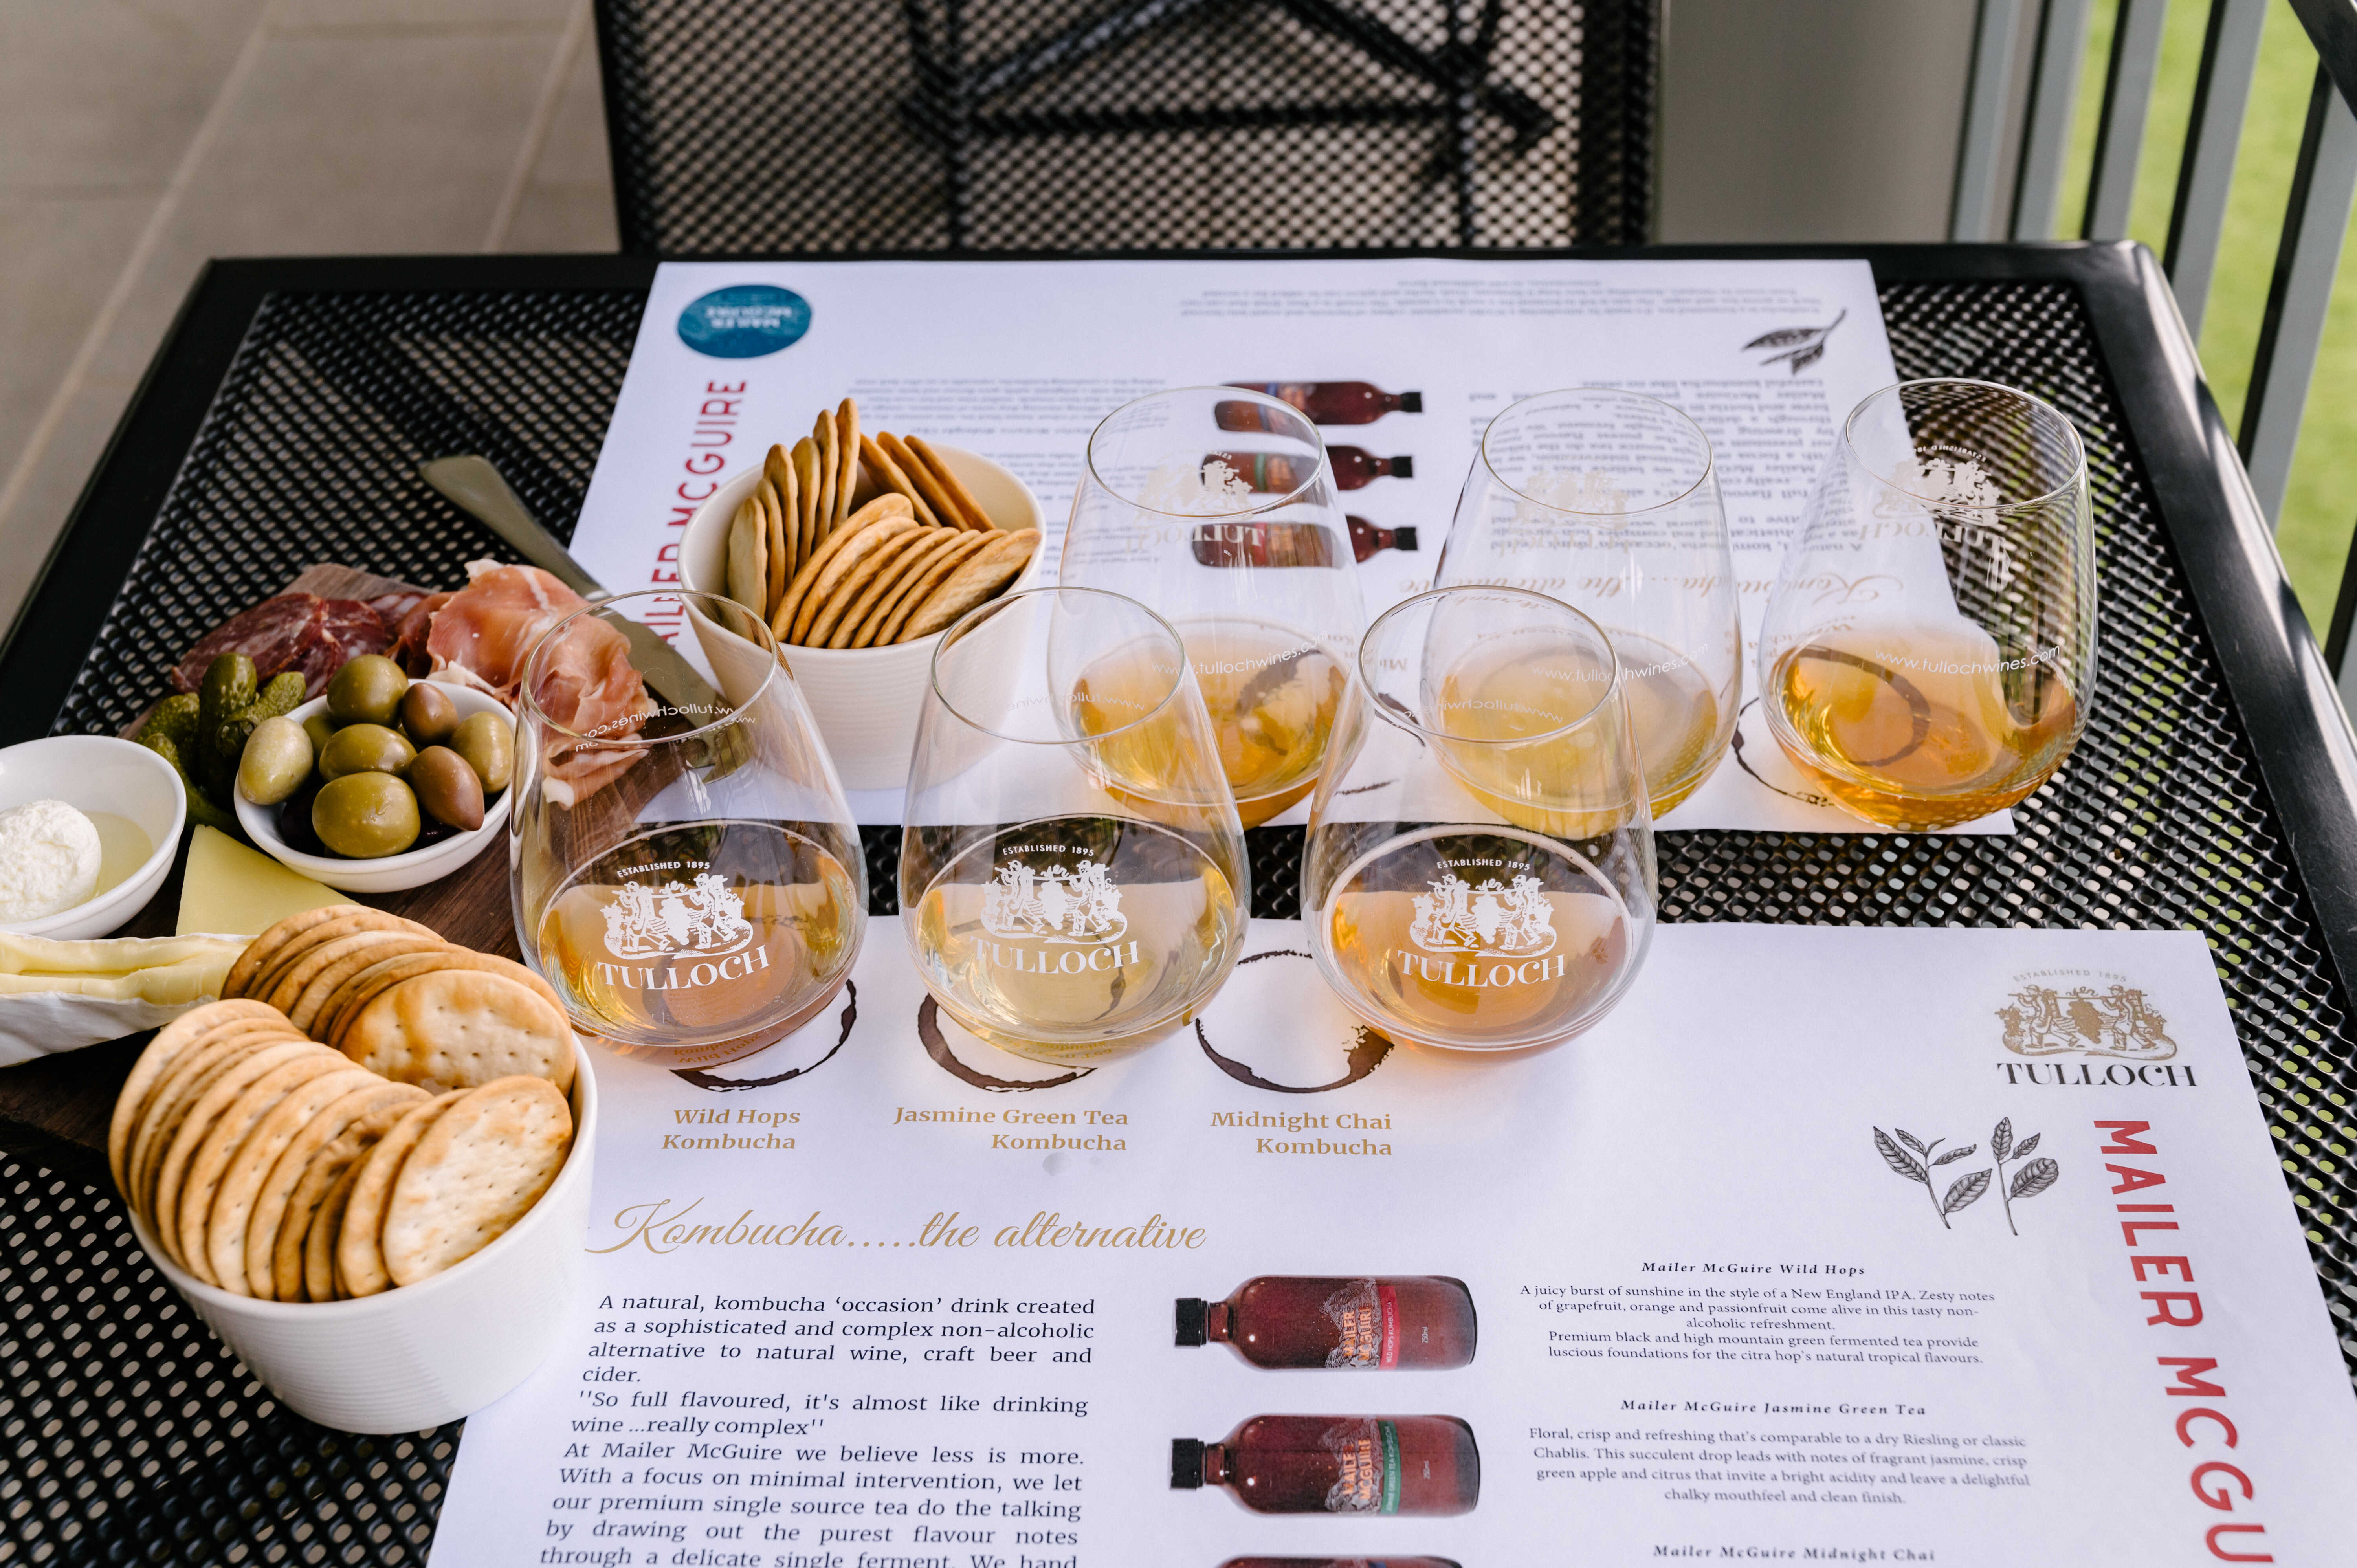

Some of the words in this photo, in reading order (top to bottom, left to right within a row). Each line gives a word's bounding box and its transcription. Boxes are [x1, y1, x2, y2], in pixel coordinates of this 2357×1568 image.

[1876, 644, 2060, 674] www.tullochwines.com
[1002, 845, 1066, 855] ESTABLISHED
[1071, 846, 1094, 857] 1895
[617, 861, 681, 878] ESTABLISHED
[686, 861, 711, 870] 1895
[1437, 859, 1502, 870] ESTABLISHED
[1508, 860, 1530, 871] 1895
[970, 935, 1140, 974] TULLOCH
[597, 944, 770, 990] TULLOCH
[1397, 950, 1566, 988] TULLOCH
[2013, 969, 2091, 981] ESTABLISHED
[2098, 970, 2127, 982] 1895
[1997, 1062, 2197, 1087] TULLOCH
[674, 1108, 730, 1124] Wild
[736, 1109, 800, 1128] Hops
[893, 1106, 995, 1125] Jasmine
[1003, 1109, 1075, 1124] Green
[1084, 1110, 1128, 1125] Tea
[1210, 1110, 1329, 1132] Midnight
[1336, 1113, 1392, 1130] Chai
[661, 1133, 796, 1149] Kombucha
[990, 1133, 1126, 1151] Kombucha
[1256, 1137, 1393, 1155] Kombucha
[994, 1211, 1207, 1249] alternative
[2093, 1121, 2203, 1327] MAILER
[1641, 1262, 1696, 1272] Mailer
[1702, 1263, 1772, 1273] McGuire
[1779, 1264, 1818, 1274] Wild
[1825, 1265, 1864, 1278] Hops
[1520, 1285, 1531, 1295] A
[1534, 1285, 1567, 1298] juicy
[1570, 1285, 1605, 1295] burst
[1608, 1286, 1623, 1296] of
[1625, 1286, 1684, 1297] sunshine
[1688, 1287, 1702, 1297] in
[1704, 1287, 1726, 1297] the
[1730, 1287, 1759, 1300] style
[1763, 1287, 1777, 1298] of
[1790, 1289, 1822, 1298] New
[1825, 1289, 1882, 1302] England
[1884, 1290, 1915, 1300] IPA.
[1919, 1290, 1955, 1303] Zesty
[1959, 1292, 1995, 1301] notes
[598, 1295, 614, 1309] A
[621, 1295, 704, 1313] natural,
[714, 1295, 825, 1312] kombucha
[951, 1298, 1009, 1313] drink
[1016, 1298, 1095, 1314] created
[1539, 1300, 1554, 1310] of
[1556, 1300, 1626, 1313] grapefruit,
[1629, 1304, 1675, 1315] orange
[1679, 1302, 1704, 1312] and
[1708, 1303, 1788, 1315] passionfruit
[1831, 1304, 1862, 1315] alive
[1865, 1305, 1880, 1315] in
[1883, 1305, 1908, 1315] this
[1911, 1306, 1943, 1319] tasty
[594, 1322, 616, 1333] as
[624, 1322, 635, 1333] a
[643, 1318, 787, 1338] sophisticated
[794, 1320, 834, 1336] and
[842, 1321, 934, 1341] complex
[941, 1322, 1094, 1339] non-alcoholic
[1686, 1317, 1746, 1329] alcoholic
[1750, 1318, 1835, 1330] refreshment.
[1343, 1310, 1356, 1357] MAILER
[1548, 1331, 1612, 1342] Premium
[1615, 1331, 1652, 1342] black
[1655, 1332, 1680, 1343] and
[1683, 1332, 1714, 1346] high
[1718, 1335, 1784, 1345] mountain
[1788, 1337, 1826, 1348] green
[1829, 1335, 1900, 1346] fermented
[1903, 1337, 1923, 1346] tea
[1926, 1337, 1979, 1350] provide
[588, 1342, 705, 1358] alternative
[720, 1344, 741, 1358] to
[756, 1344, 835, 1360] natural
[849, 1346, 907, 1364] wine,
[924, 1345, 975, 1361] craft
[990, 1346, 1038, 1362] beer
[1052, 1347, 1091, 1363] and
[1548, 1346, 1603, 1357] luscious
[1607, 1347, 1688, 1359] foundations
[1692, 1348, 1712, 1359] for
[1716, 1349, 1737, 1360] the
[1741, 1350, 1772, 1361] citra
[1774, 1350, 1812, 1364] hop's
[1815, 1351, 1864, 1362] natural
[1867, 1352, 1921, 1365] tropical
[1924, 1352, 1983, 1363] flavours.
[583, 1366, 640, 1382] cider.
[630, 1391, 668, 1407] full
[680, 1391, 790, 1413] flavoured,
[804, 1394, 839, 1410] it's
[852, 1394, 928, 1411] almost
[939, 1395, 980, 1411] like
[993, 1396, 1089, 1418] drinking
[1620, 1399, 1677, 1411] Mailer
[1684, 1401, 1757, 1413] McGuire
[1763, 1402, 1831, 1415] Jasmine
[1838, 1403, 1888, 1415] Green
[1895, 1404, 1926, 1415] Tea
[571, 1416, 624, 1432] wine
[563, 1443, 590, 1458] At
[601, 1441, 675, 1458] Mailer
[686, 1443, 782, 1460] McGuire
[796, 1449, 827, 1461] we
[840, 1445, 918, 1462] believe
[932, 1446, 974, 1463] less
[988, 1447, 1005, 1463] is
[1020, 1452, 1084, 1465] more.
[1664, 1488, 1710, 1504] chalky
[1714, 1489, 1787, 1502] mouthfeel
[1790, 1490, 1817, 1502] and
[1820, 1490, 1858, 1503] clean
[1862, 1491, 1906, 1504] finish.
[1653, 1544, 1712, 1557] Mailer
[1719, 1546, 1796, 1559] McGuire
[1803, 1547, 1886, 1563] Midnight
[1893, 1548, 1935, 1561] Chai
